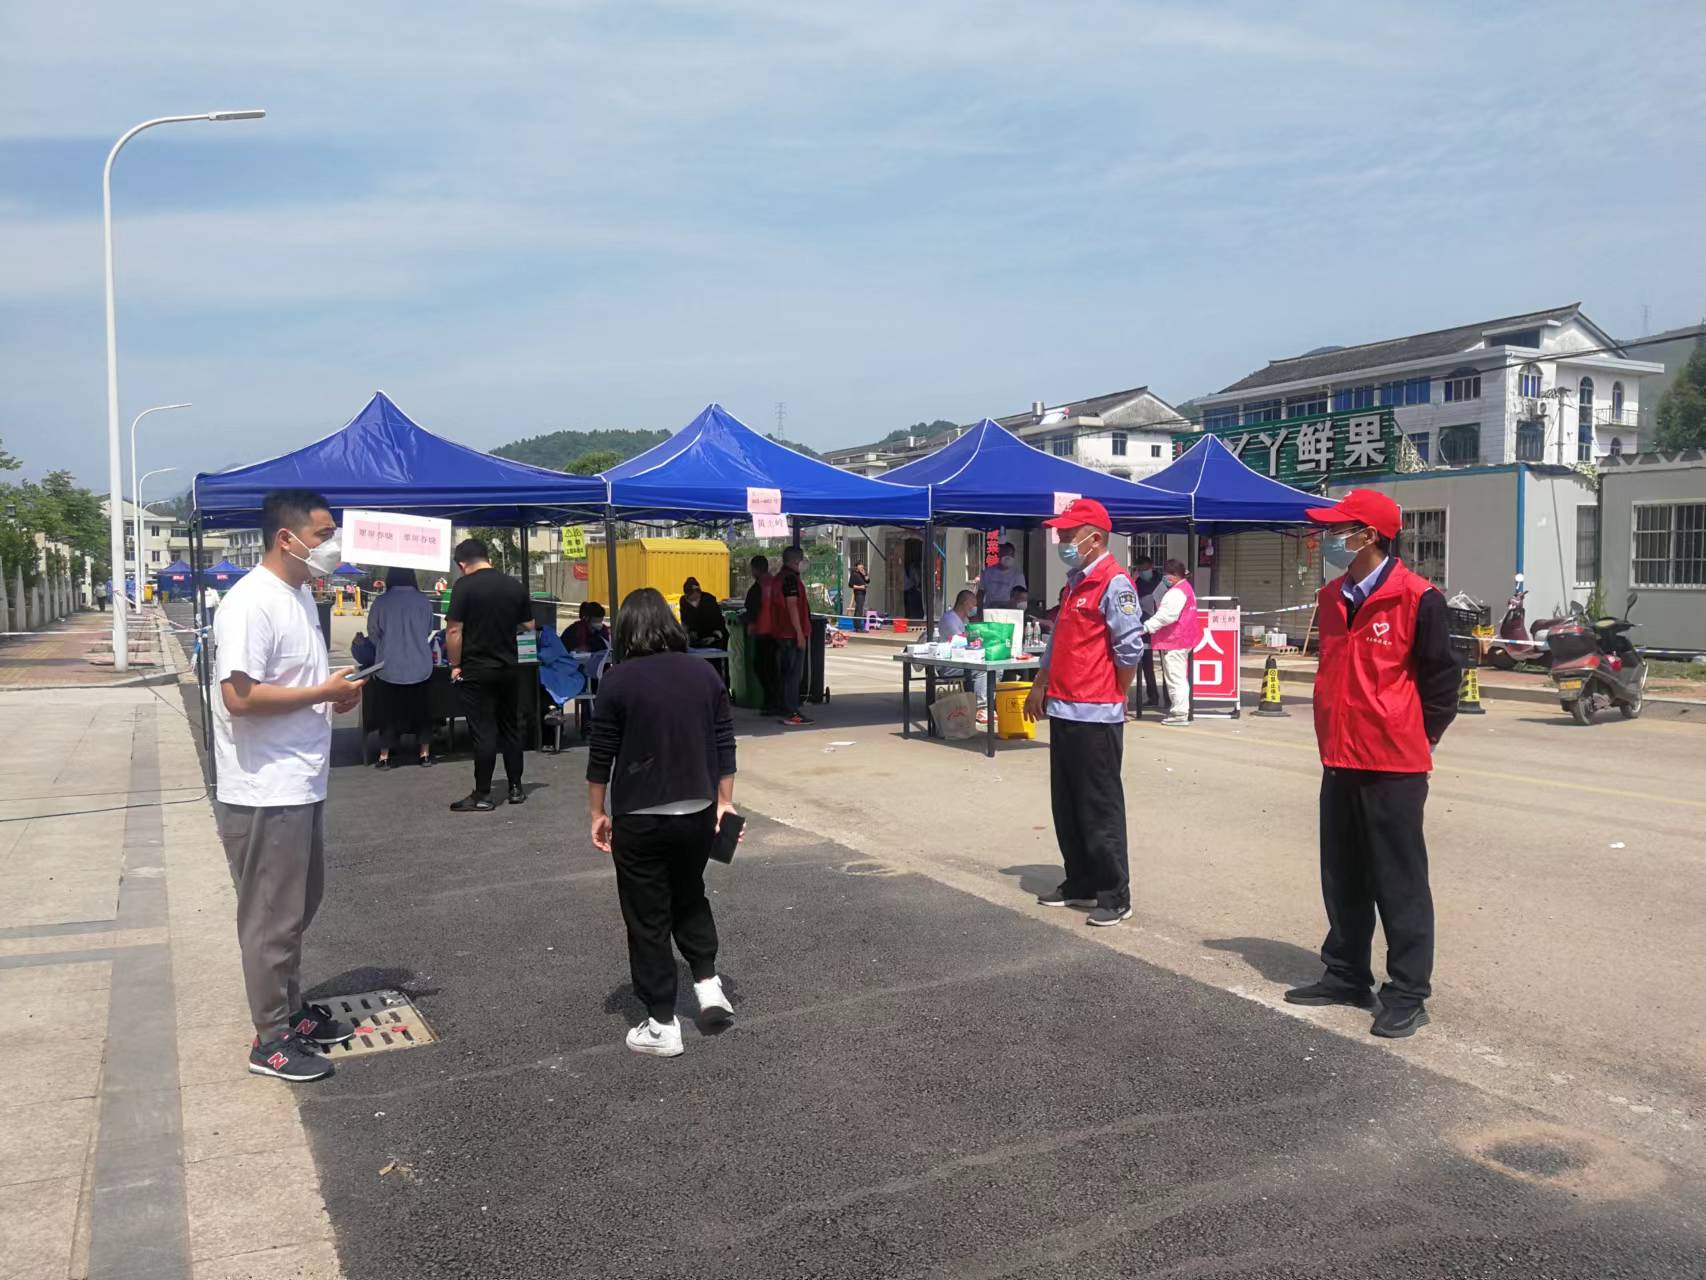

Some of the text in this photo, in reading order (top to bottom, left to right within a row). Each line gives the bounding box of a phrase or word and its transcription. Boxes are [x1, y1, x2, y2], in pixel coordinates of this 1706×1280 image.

[1193, 628, 1225, 685] 入口
[295, 1018, 318, 1035] N
[267, 1051, 289, 1070] N
